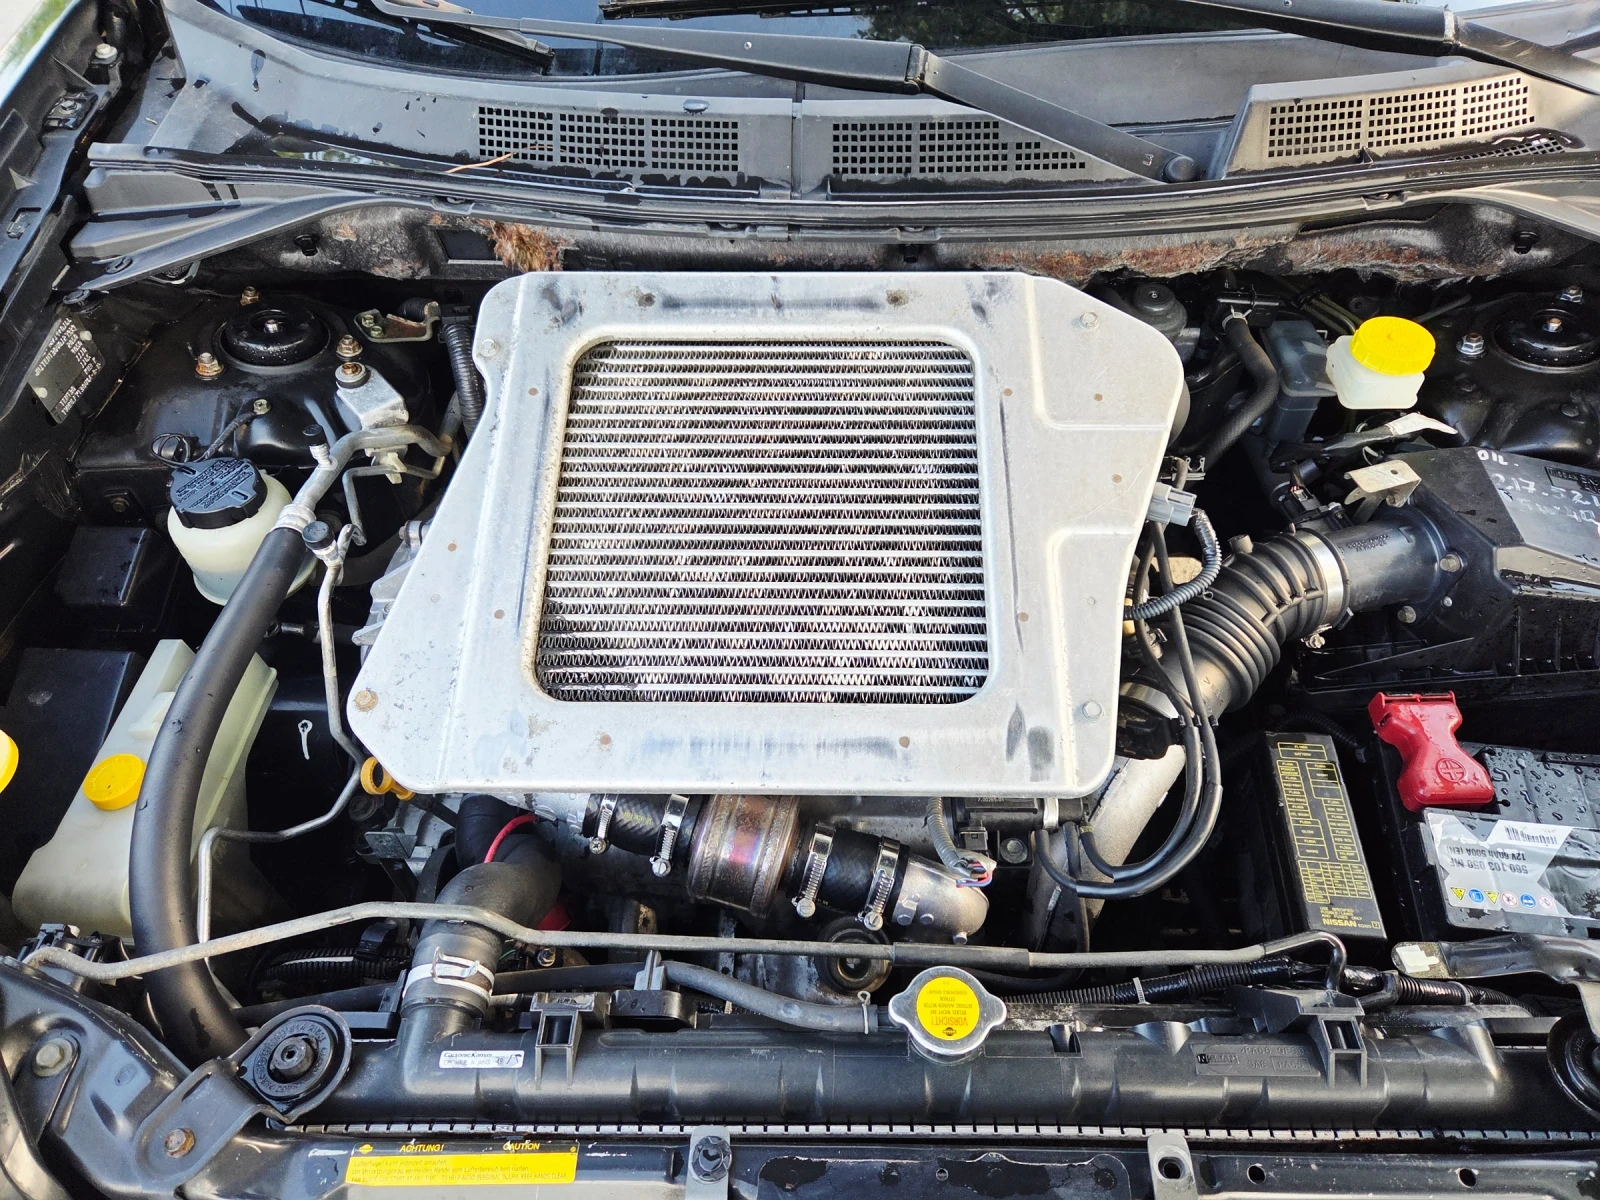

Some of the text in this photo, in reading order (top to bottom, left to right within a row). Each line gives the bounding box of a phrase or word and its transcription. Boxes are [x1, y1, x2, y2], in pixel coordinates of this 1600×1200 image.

[1466, 848, 1487, 858] 500A
[1486, 850, 1510, 860] 60Ah
[1511, 852, 1526, 861] 12V
[1449, 857, 1529, 874] 560 103 050 MF
[1322, 918, 1357, 927] NISSAN
[399, 1143, 445, 1153] ACHTUNG!
[502, 1142, 541, 1152] CAUTION
